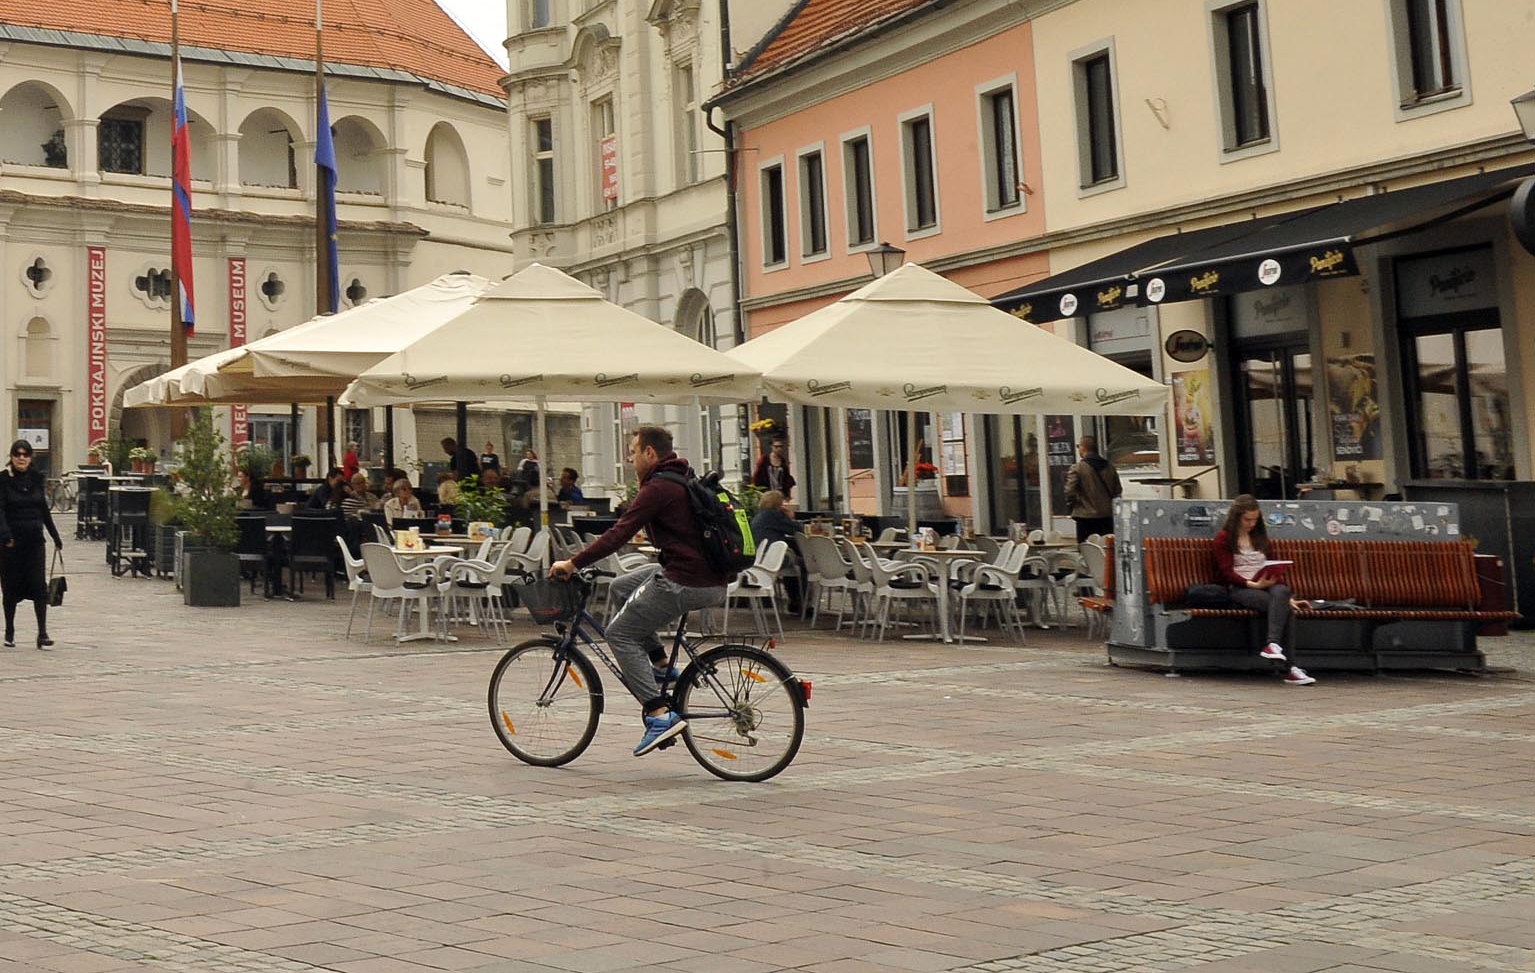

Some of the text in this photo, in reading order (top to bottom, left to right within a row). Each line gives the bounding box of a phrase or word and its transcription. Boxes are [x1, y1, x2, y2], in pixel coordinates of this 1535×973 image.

[91, 249, 105, 431] POKRAJINSKI MUZEJ
[231, 260, 245, 338] MUSEUM
